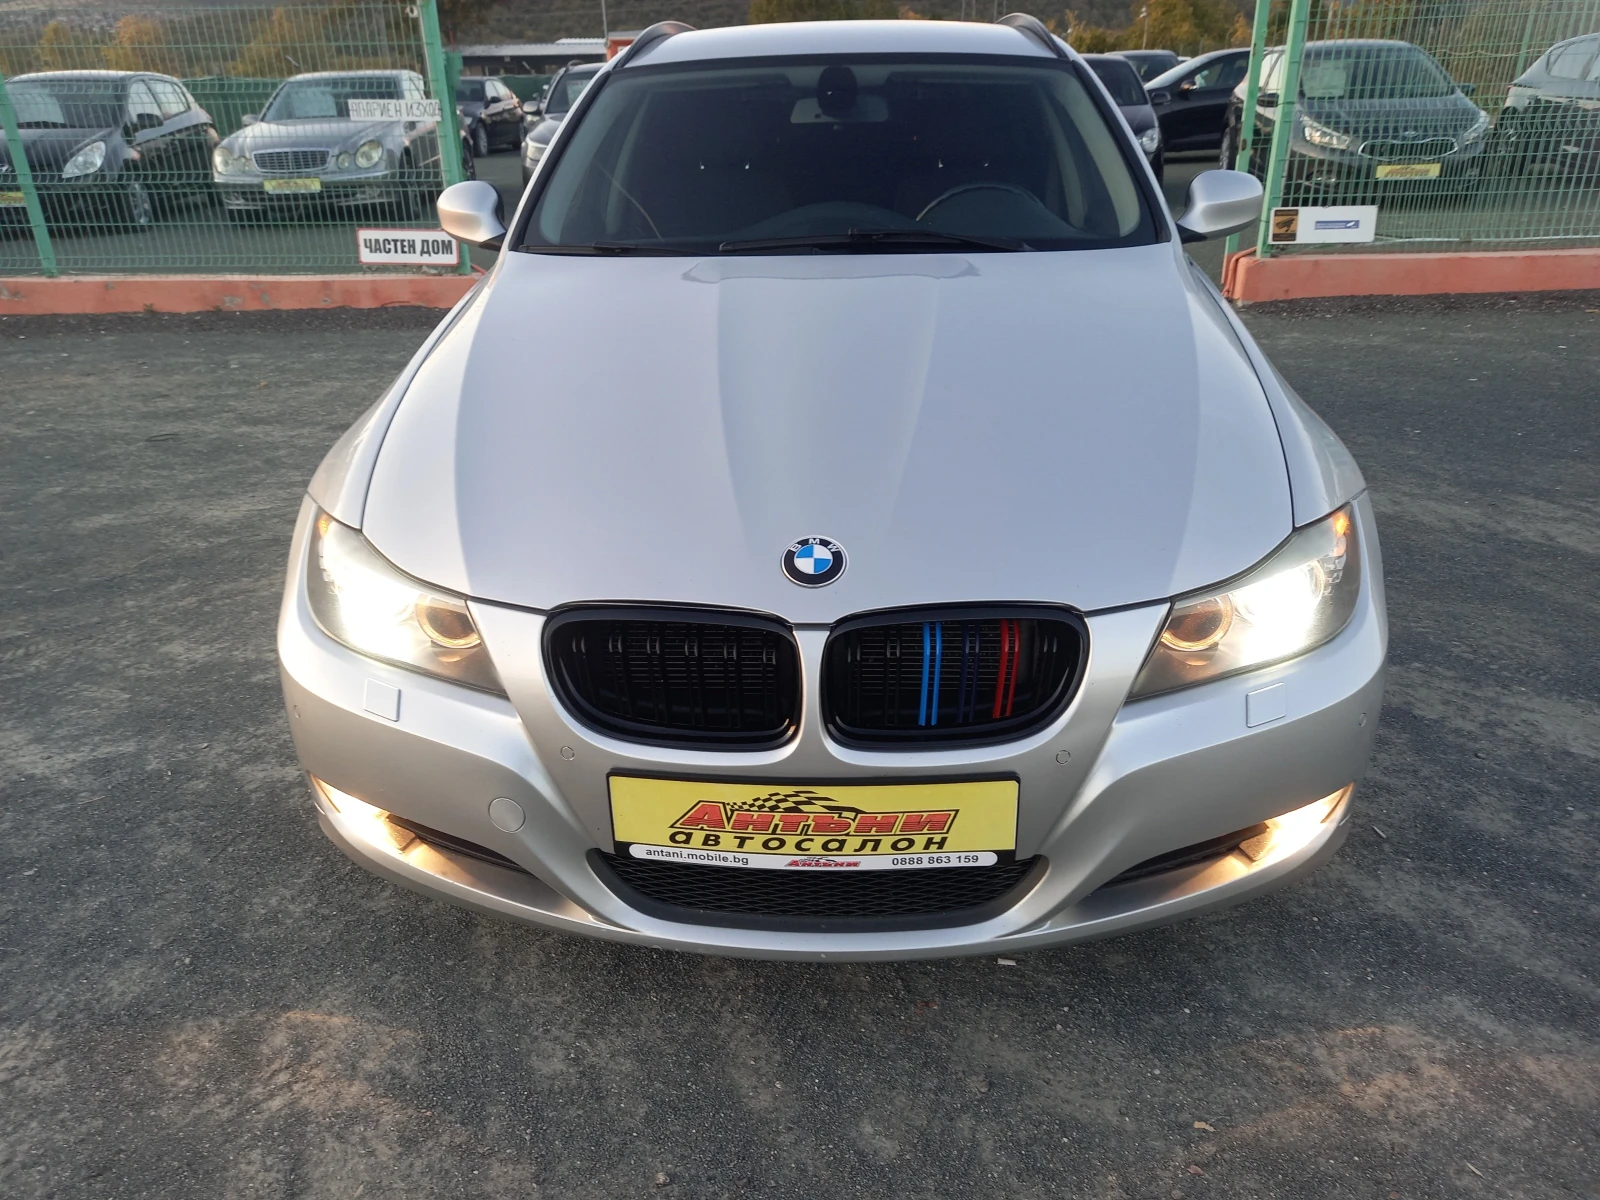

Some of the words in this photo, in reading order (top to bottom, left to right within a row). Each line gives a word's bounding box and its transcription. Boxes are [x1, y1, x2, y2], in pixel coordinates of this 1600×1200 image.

[351, 101, 402, 118] АВАРИЕН
[405, 101, 441, 117] ИЗХОД
[363, 238, 417, 255] ЧАСТЕН
[420, 239, 453, 257] ДОМ
[788, 538, 840, 552] BMW
[668, 830, 949, 853] автосалон
[645, 847, 749, 866] antani.mobile.bg
[891, 856, 924, 866] 0888
[927, 855, 951, 865] 863
[956, 854, 979, 864] 159
